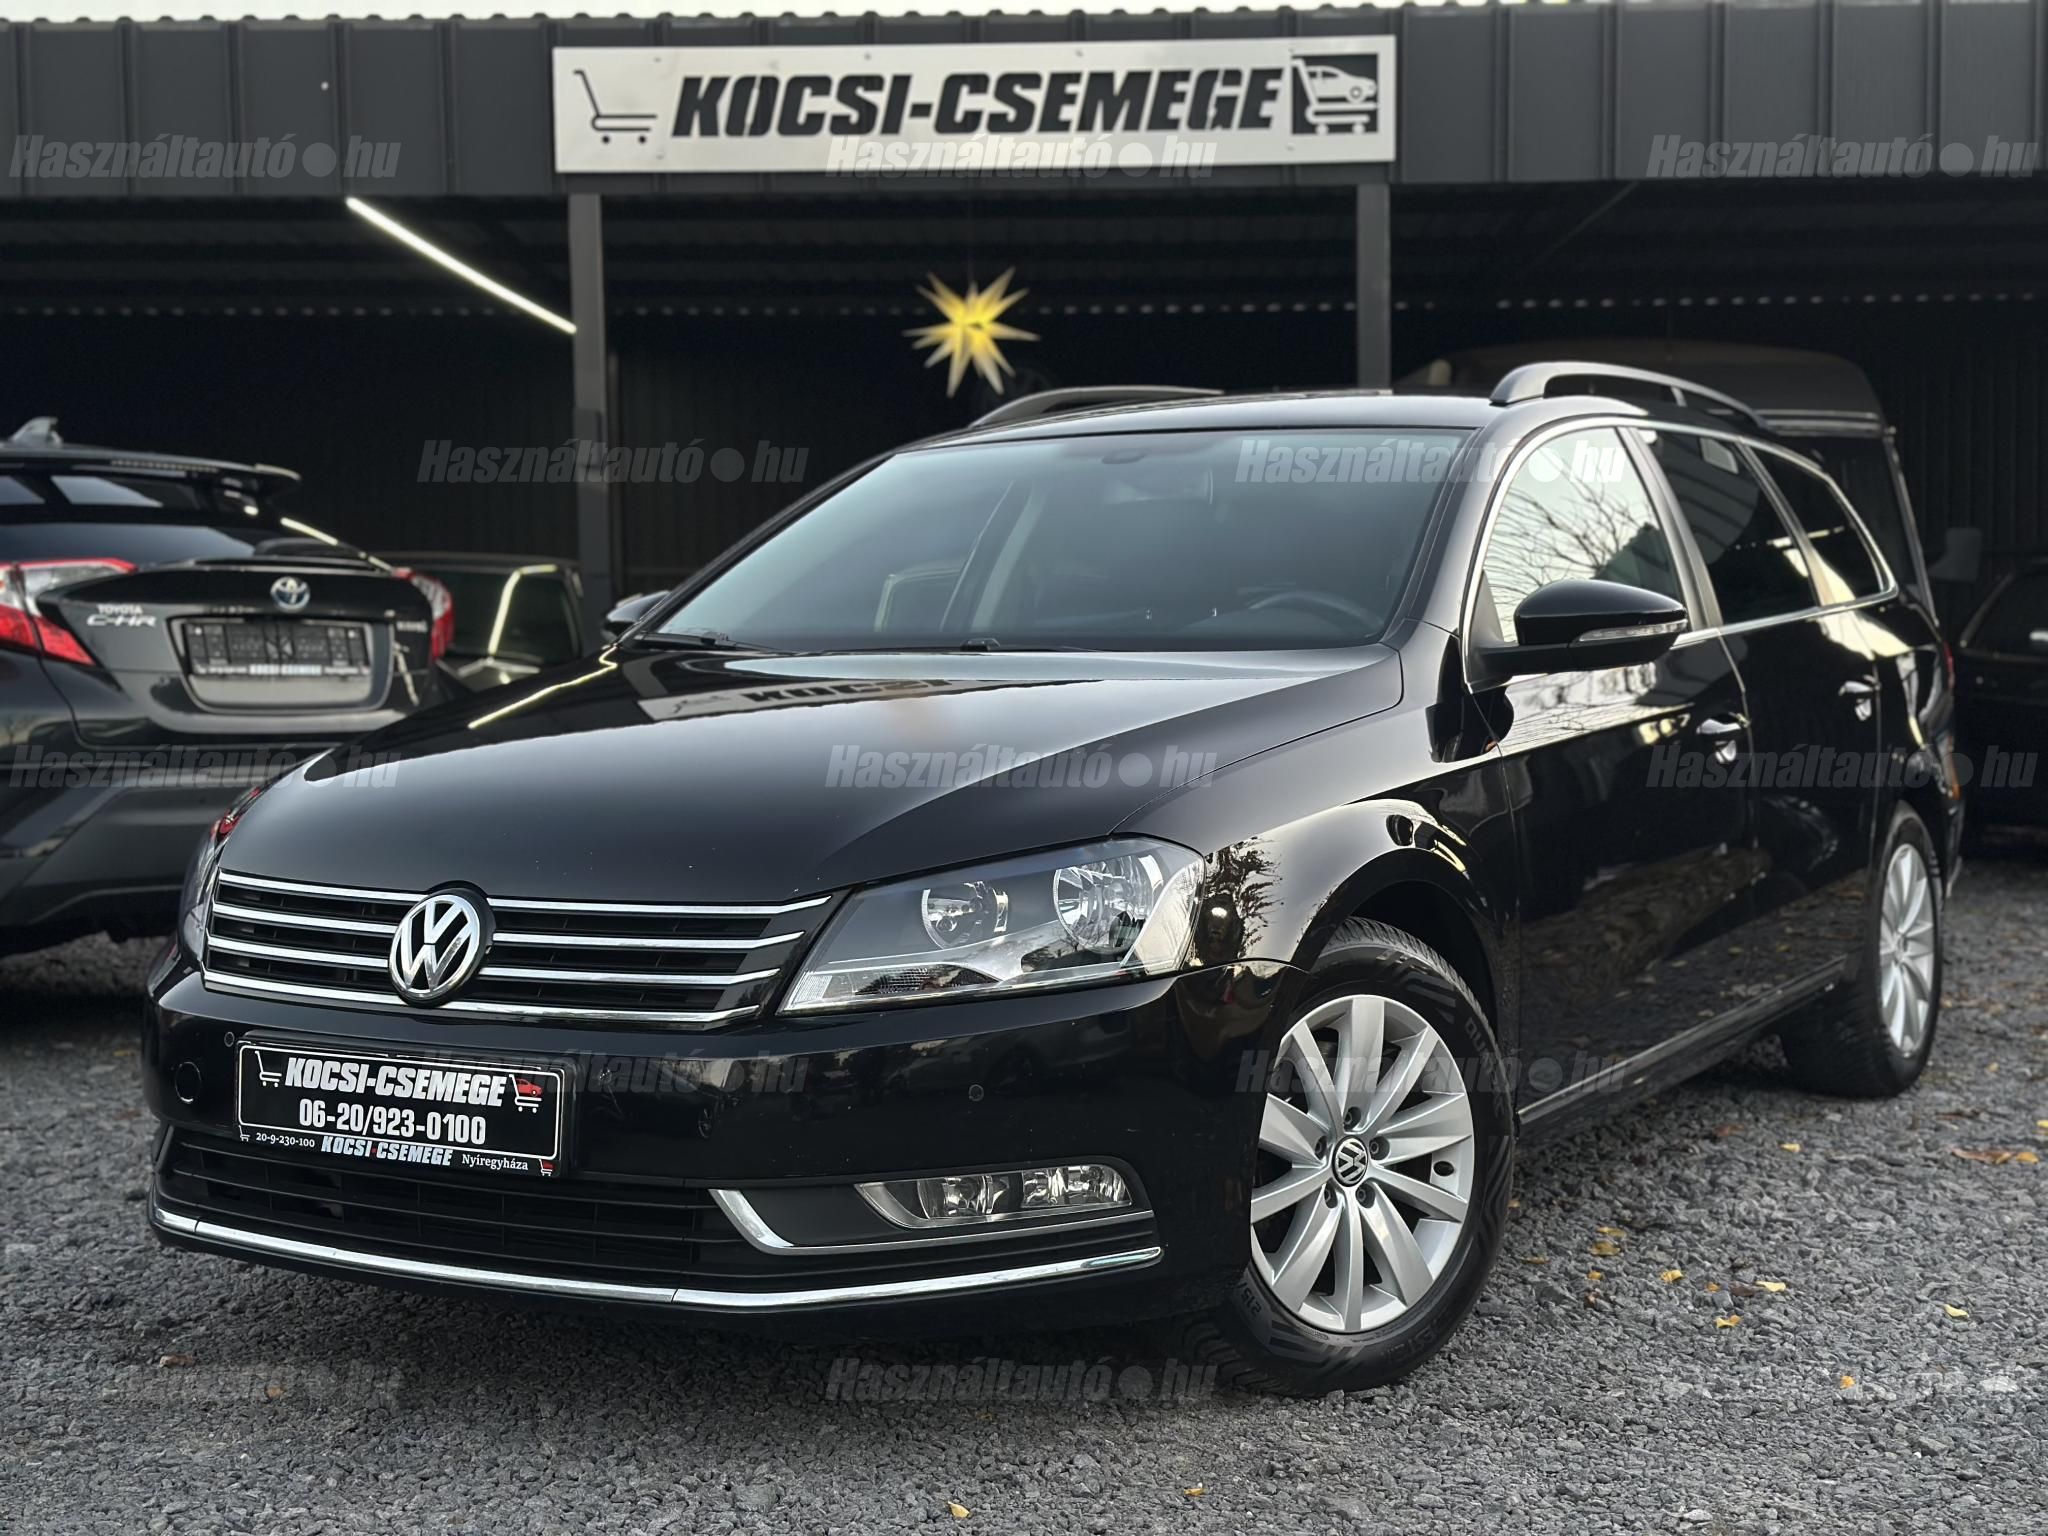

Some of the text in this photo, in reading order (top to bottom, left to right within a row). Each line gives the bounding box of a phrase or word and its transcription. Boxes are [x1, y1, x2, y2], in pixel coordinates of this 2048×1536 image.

[672, 67, 1287, 138] KOCSI-CSEMEGE
[284, 1057, 508, 1108] KOCSI-CSEMEGE
[299, 1098, 487, 1146] 06-20/923-0100
[255, 1131, 529, 1172] 20-9-230-100 KOCSI-CSEMEGE Nyíregyháza
